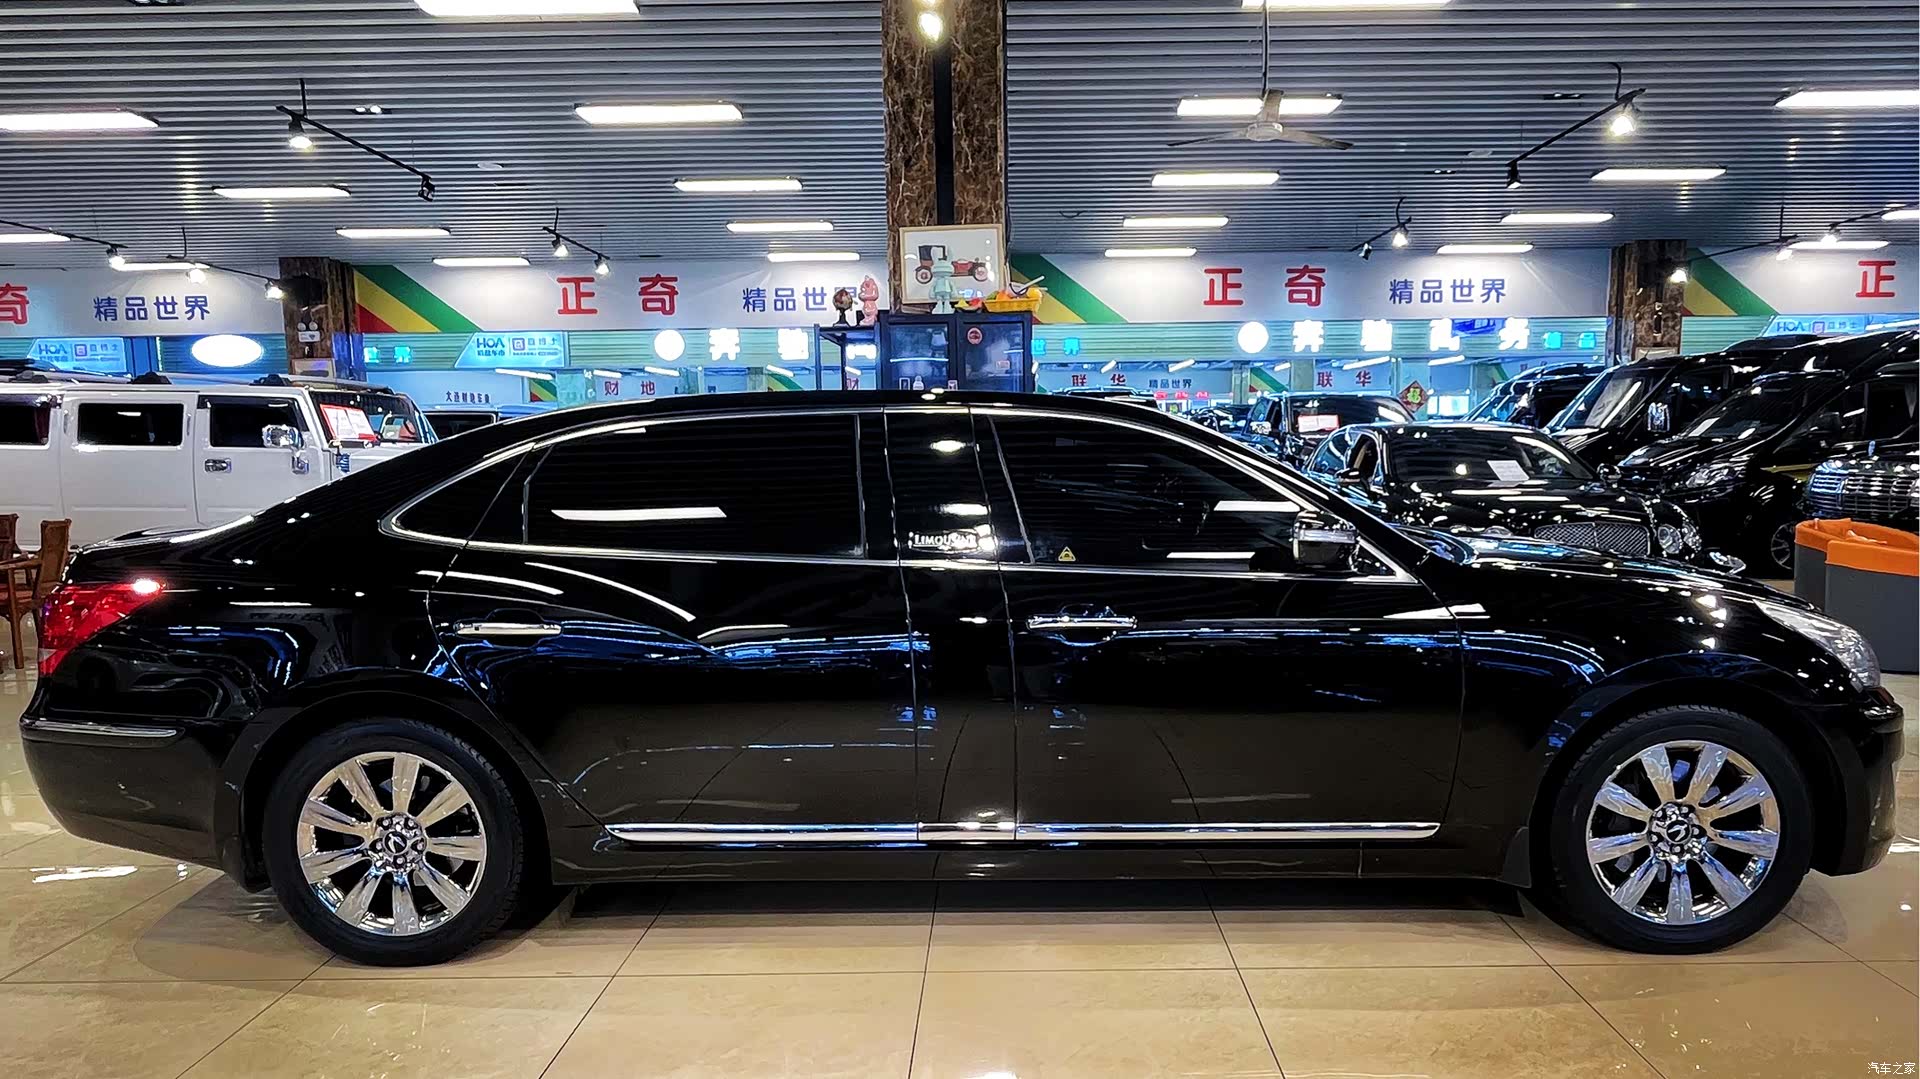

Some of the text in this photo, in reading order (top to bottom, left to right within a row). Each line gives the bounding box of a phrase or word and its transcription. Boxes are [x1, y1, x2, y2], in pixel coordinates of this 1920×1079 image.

[1203, 264, 1507, 307] 正奇 精品世界
[1855, 260, 1897, 298] 正
[557, 273, 679, 316] 正奇
[93, 295, 210, 322] 精品世界
[476, 337, 505, 348] HOA
[1149, 379, 1192, 389] 精品世界
[1316, 371, 1372, 388] 联华
